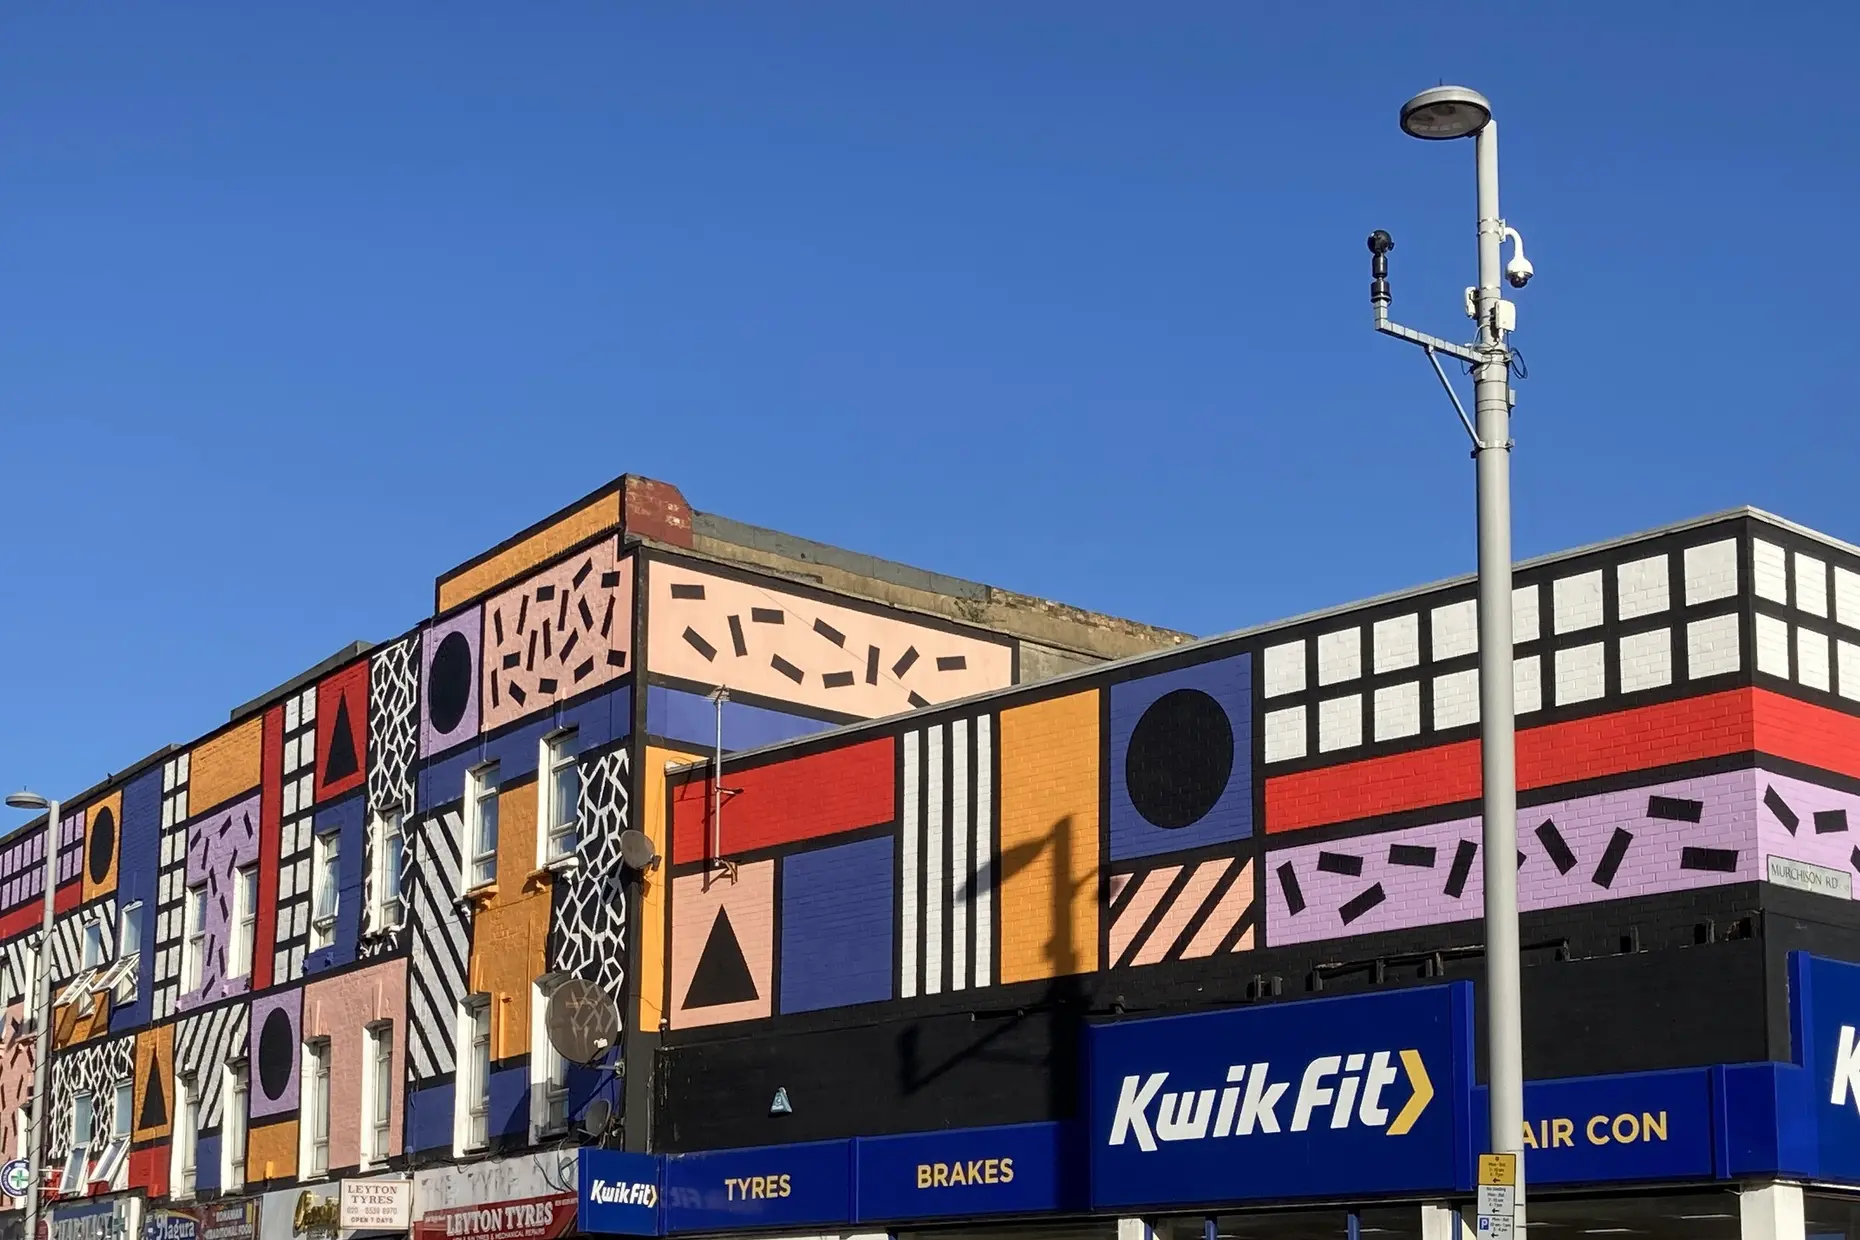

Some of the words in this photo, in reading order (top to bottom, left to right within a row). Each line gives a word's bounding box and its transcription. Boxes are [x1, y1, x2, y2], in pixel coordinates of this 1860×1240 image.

[1771, 863, 1822, 885] MURCHISON
[1825, 877, 1838, 889] RD
[1522, 1118, 1574, 1149] AIR
[1586, 1111, 1667, 1146] CON
[917, 1157, 1014, 1189] BRAKES
[347, 1185, 398, 1194] LEYTON
[351, 1195, 394, 1204] TYRES
[724, 1174, 791, 1201] TYRES
[446, 1208, 503, 1237] LEYTON
[505, 1201, 554, 1230] TYRES
